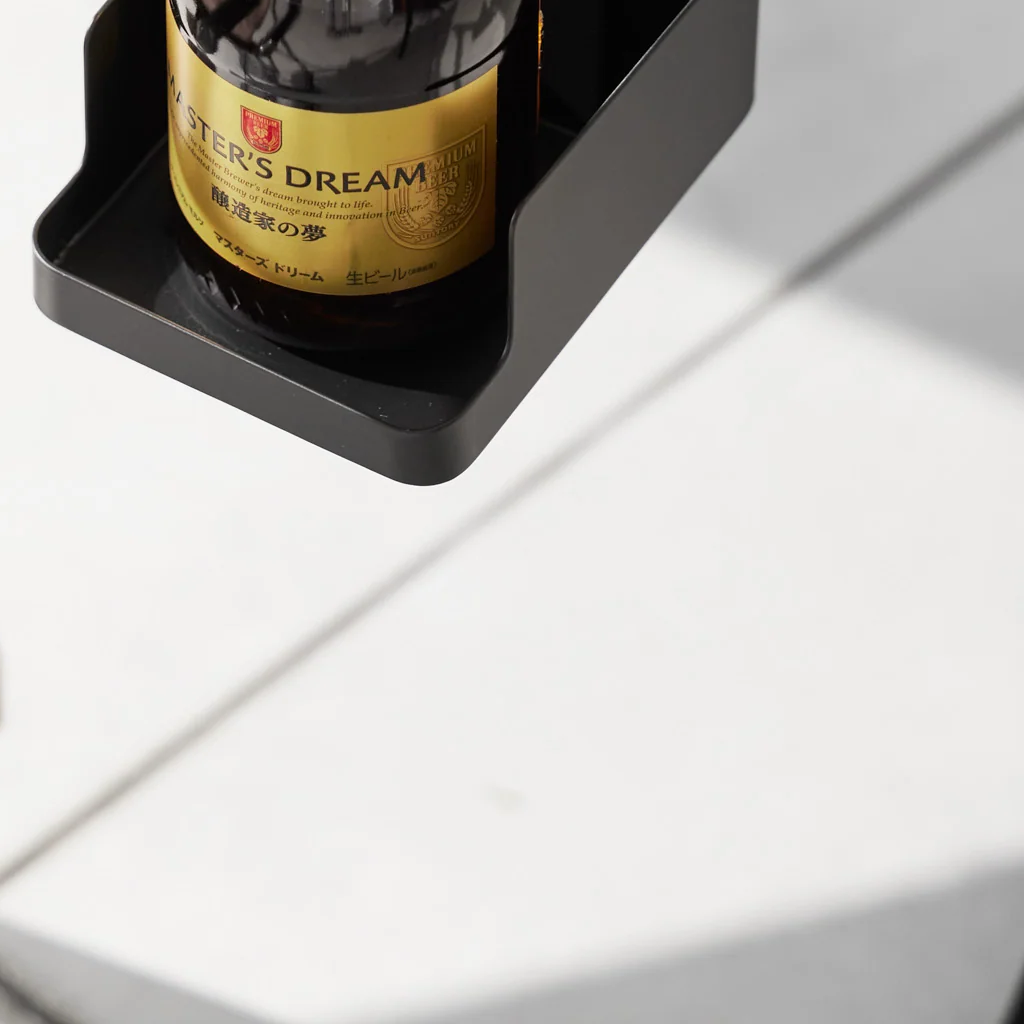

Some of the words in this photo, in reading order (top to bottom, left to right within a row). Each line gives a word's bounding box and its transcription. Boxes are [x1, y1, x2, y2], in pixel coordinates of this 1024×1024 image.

[198, 146, 222, 170] Master
[223, 167, 261, 192] Brewer's
[262, 185, 294, 203] dream
[296, 195, 338, 210] brought
[340, 201, 351, 209] to
[353, 200, 374, 211] life.
[210, 168, 247, 198] harmony
[248, 192, 259, 204] of
[260, 197, 301, 217] heritage
[302, 210, 323, 219] and
[325, 210, 383, 221] innovation
[285, 161, 427, 195] DREAM
[211, 182, 327, 242] 醸造家の夢
[213, 230, 270, 269] マスターズ
[274, 262, 325, 283] ドリーム
[345, 267, 407, 286] 生ビール
